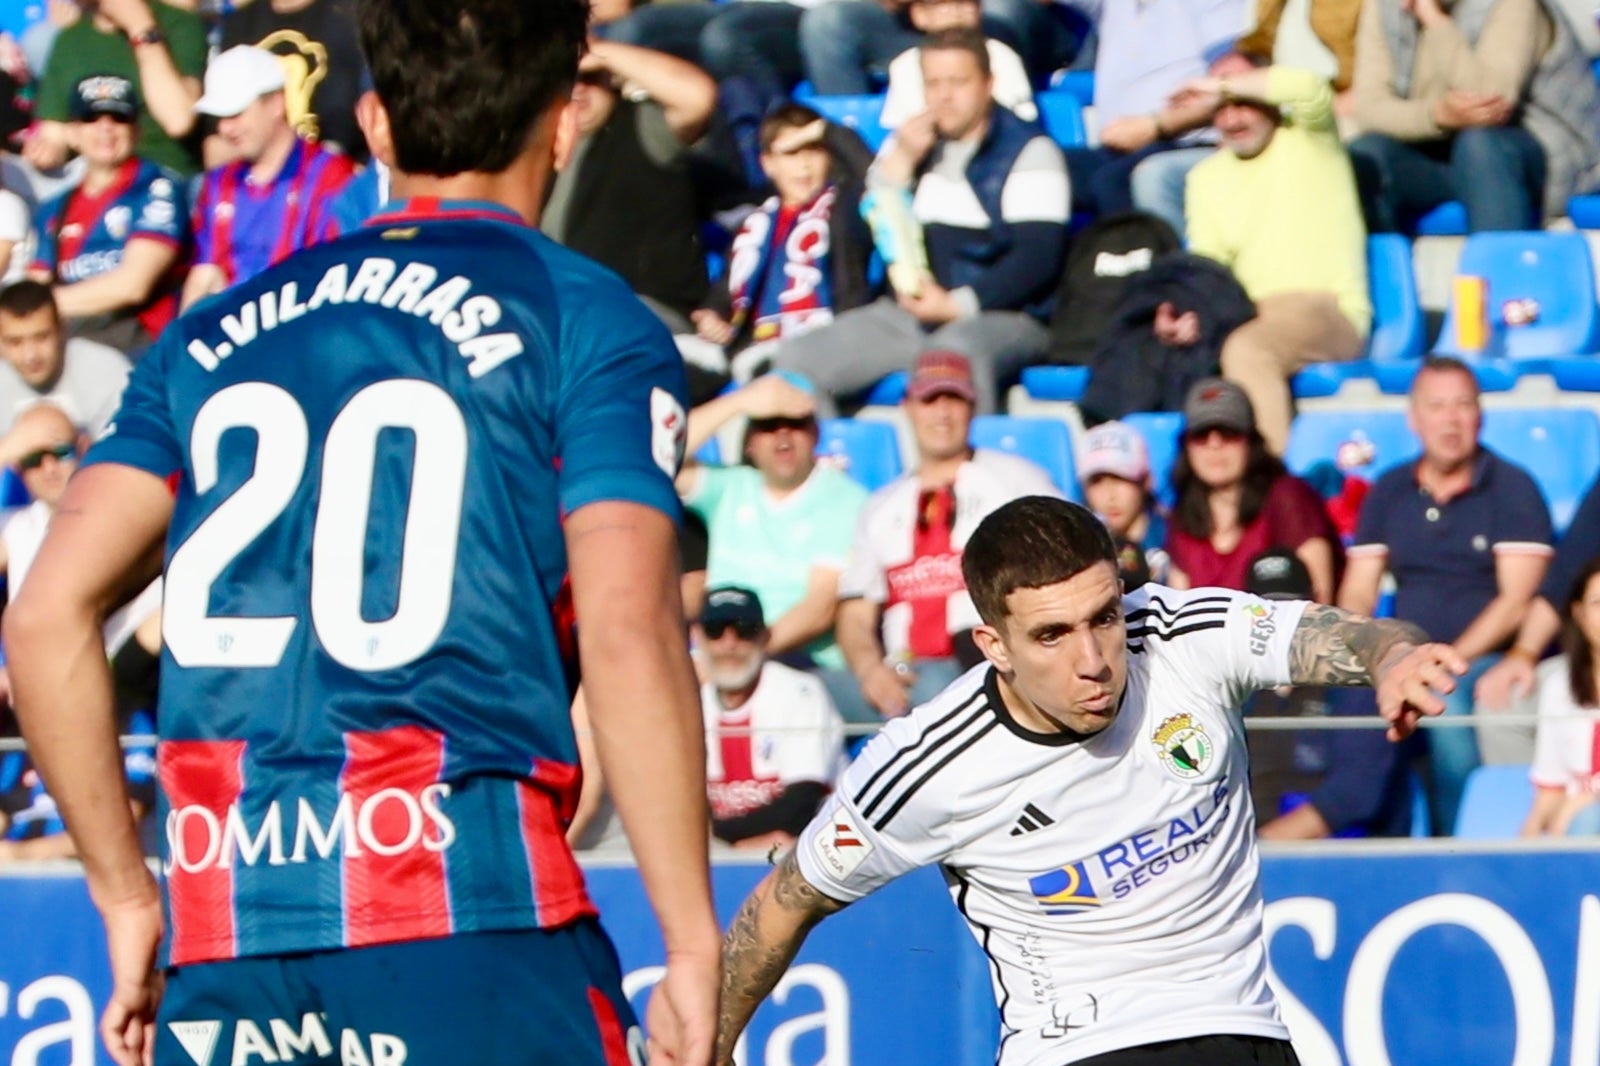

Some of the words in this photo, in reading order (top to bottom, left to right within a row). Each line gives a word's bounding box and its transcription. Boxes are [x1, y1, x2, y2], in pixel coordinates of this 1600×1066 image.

[187, 256, 524, 378] I.VILARRASA
[161, 378, 468, 672] 20
[163, 781, 456, 877] SOMMOS
